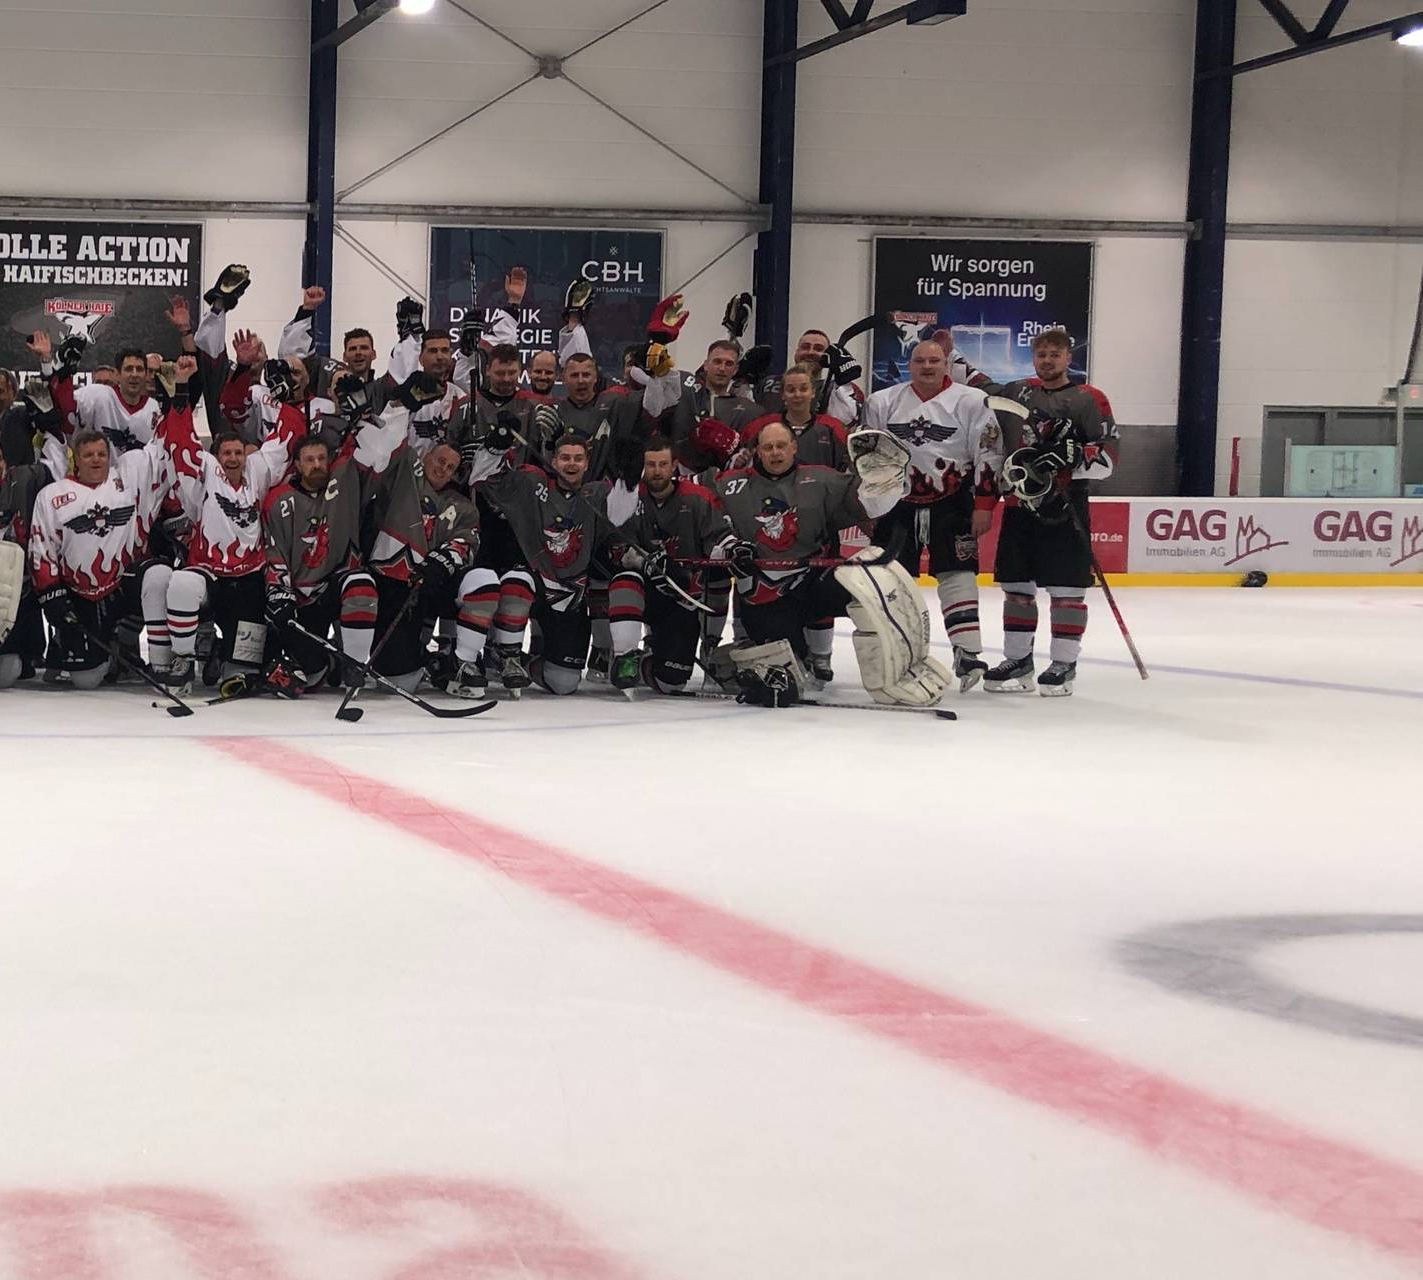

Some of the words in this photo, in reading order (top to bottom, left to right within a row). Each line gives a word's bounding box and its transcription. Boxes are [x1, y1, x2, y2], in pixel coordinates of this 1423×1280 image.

[76, 235, 190, 263] ACTION
[4, 264, 188, 287] HAIFISCHBECKEN!
[581, 260, 644, 283] CBH
[931, 254, 962, 273] Wir
[967, 257, 1034, 277] sorgen
[917, 278, 944, 296] für
[948, 278, 1047, 302] Spannung
[725, 478, 749, 497] 37
[1145, 508, 1227, 541] GAG
[1313, 510, 1393, 542] GAG
[1145, 546, 1206, 557] Immobilien
[1209, 548, 1226, 558] AG
[1376, 548, 1392, 558] AG
